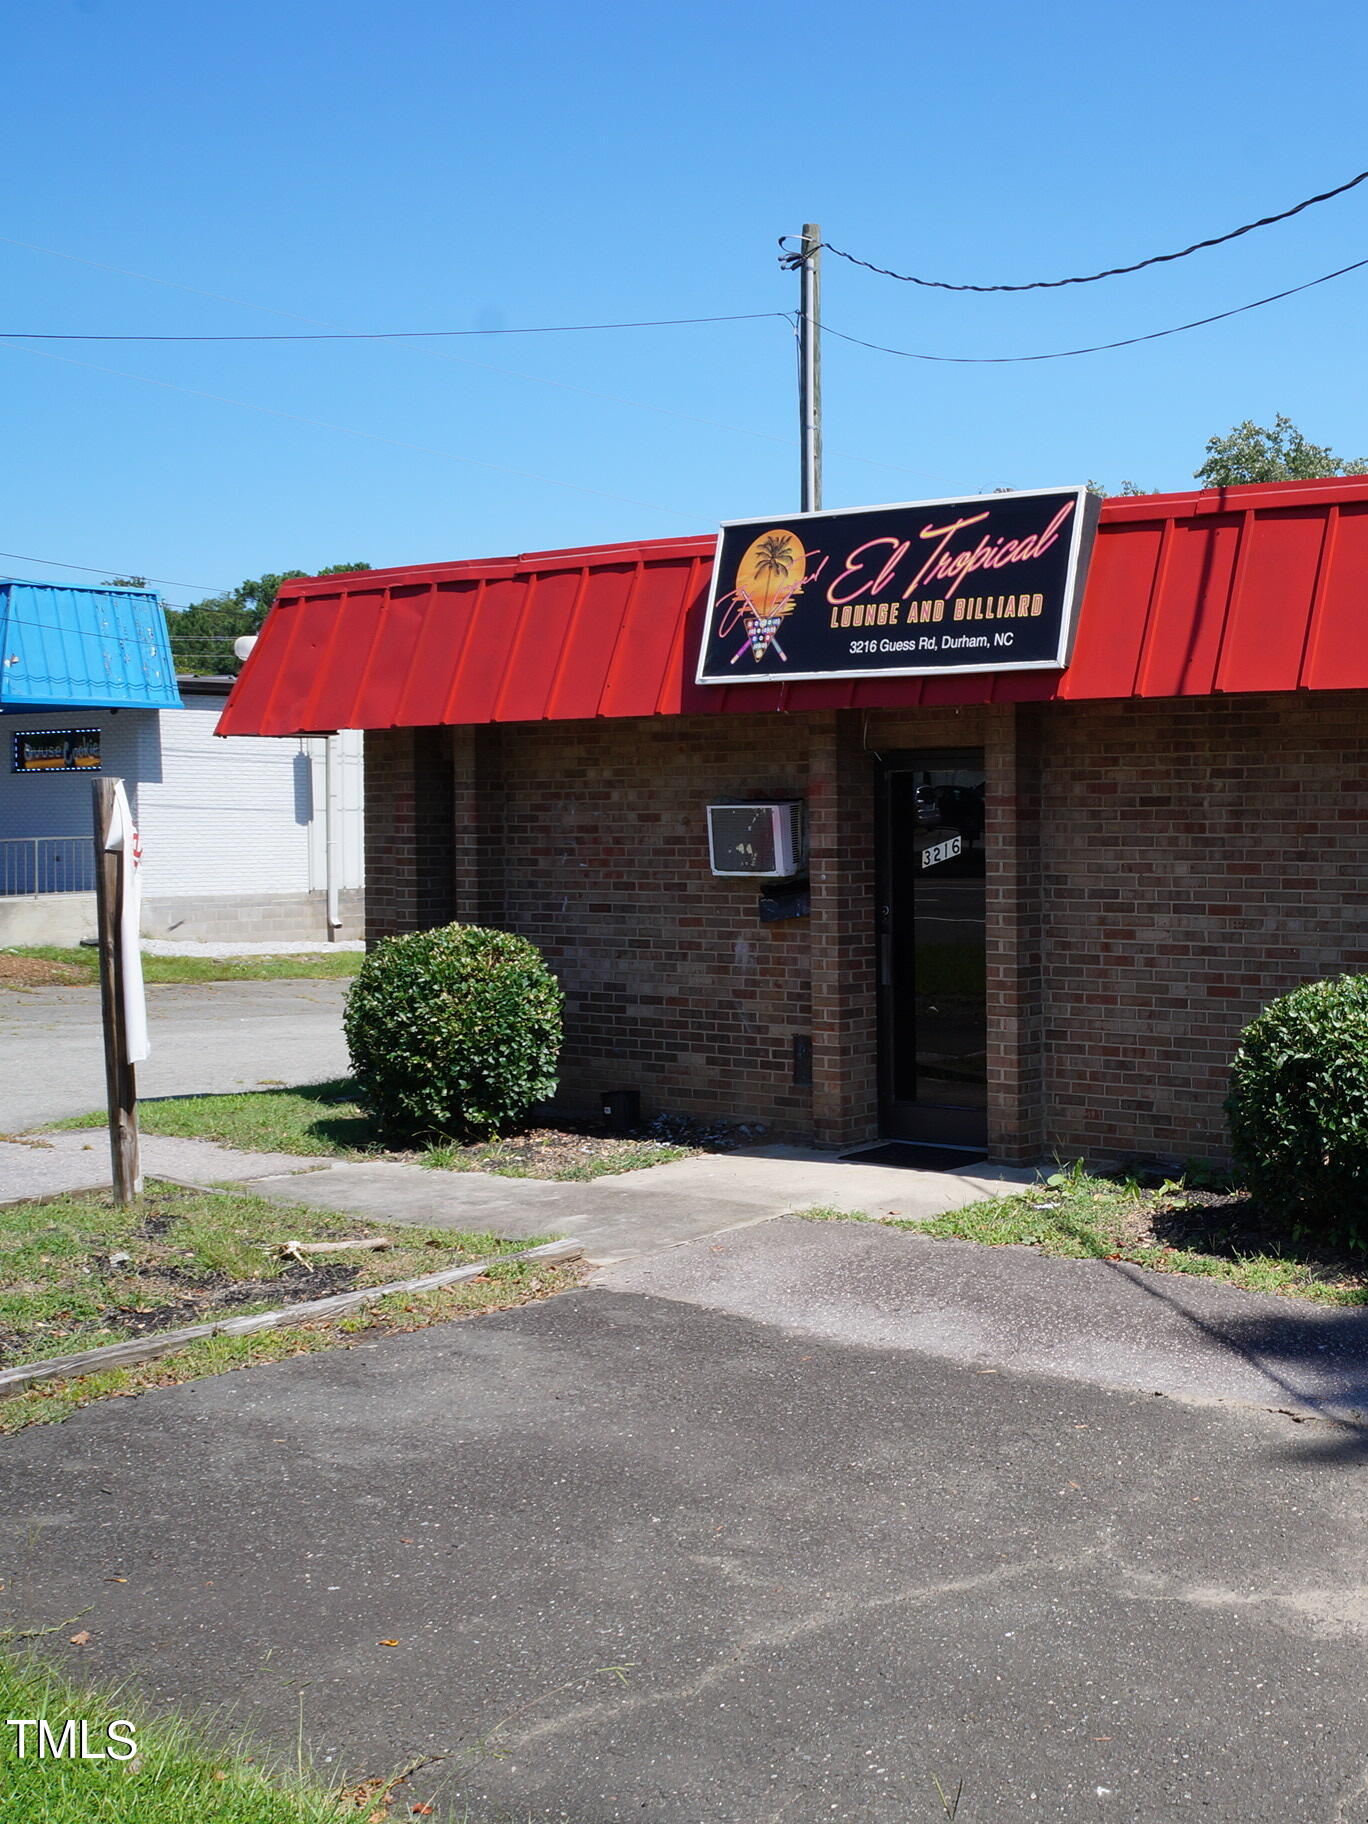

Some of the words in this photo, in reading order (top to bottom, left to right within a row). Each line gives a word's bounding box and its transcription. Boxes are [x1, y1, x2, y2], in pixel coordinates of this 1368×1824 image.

[826, 537, 911, 605] El
[902, 500, 1075, 600] Tropical
[830, 603, 900, 628] LOUNGE
[907, 599, 945, 623] AND
[953, 593, 1043, 621] BILLIARD
[849, 640, 877, 654] 3216
[879, 637, 916, 652] Guess
[918, 636, 938, 652] Rd,
[941, 634, 991, 649] Durham,
[994, 632, 1014, 646] NC
[923, 838, 960, 865] 3216
